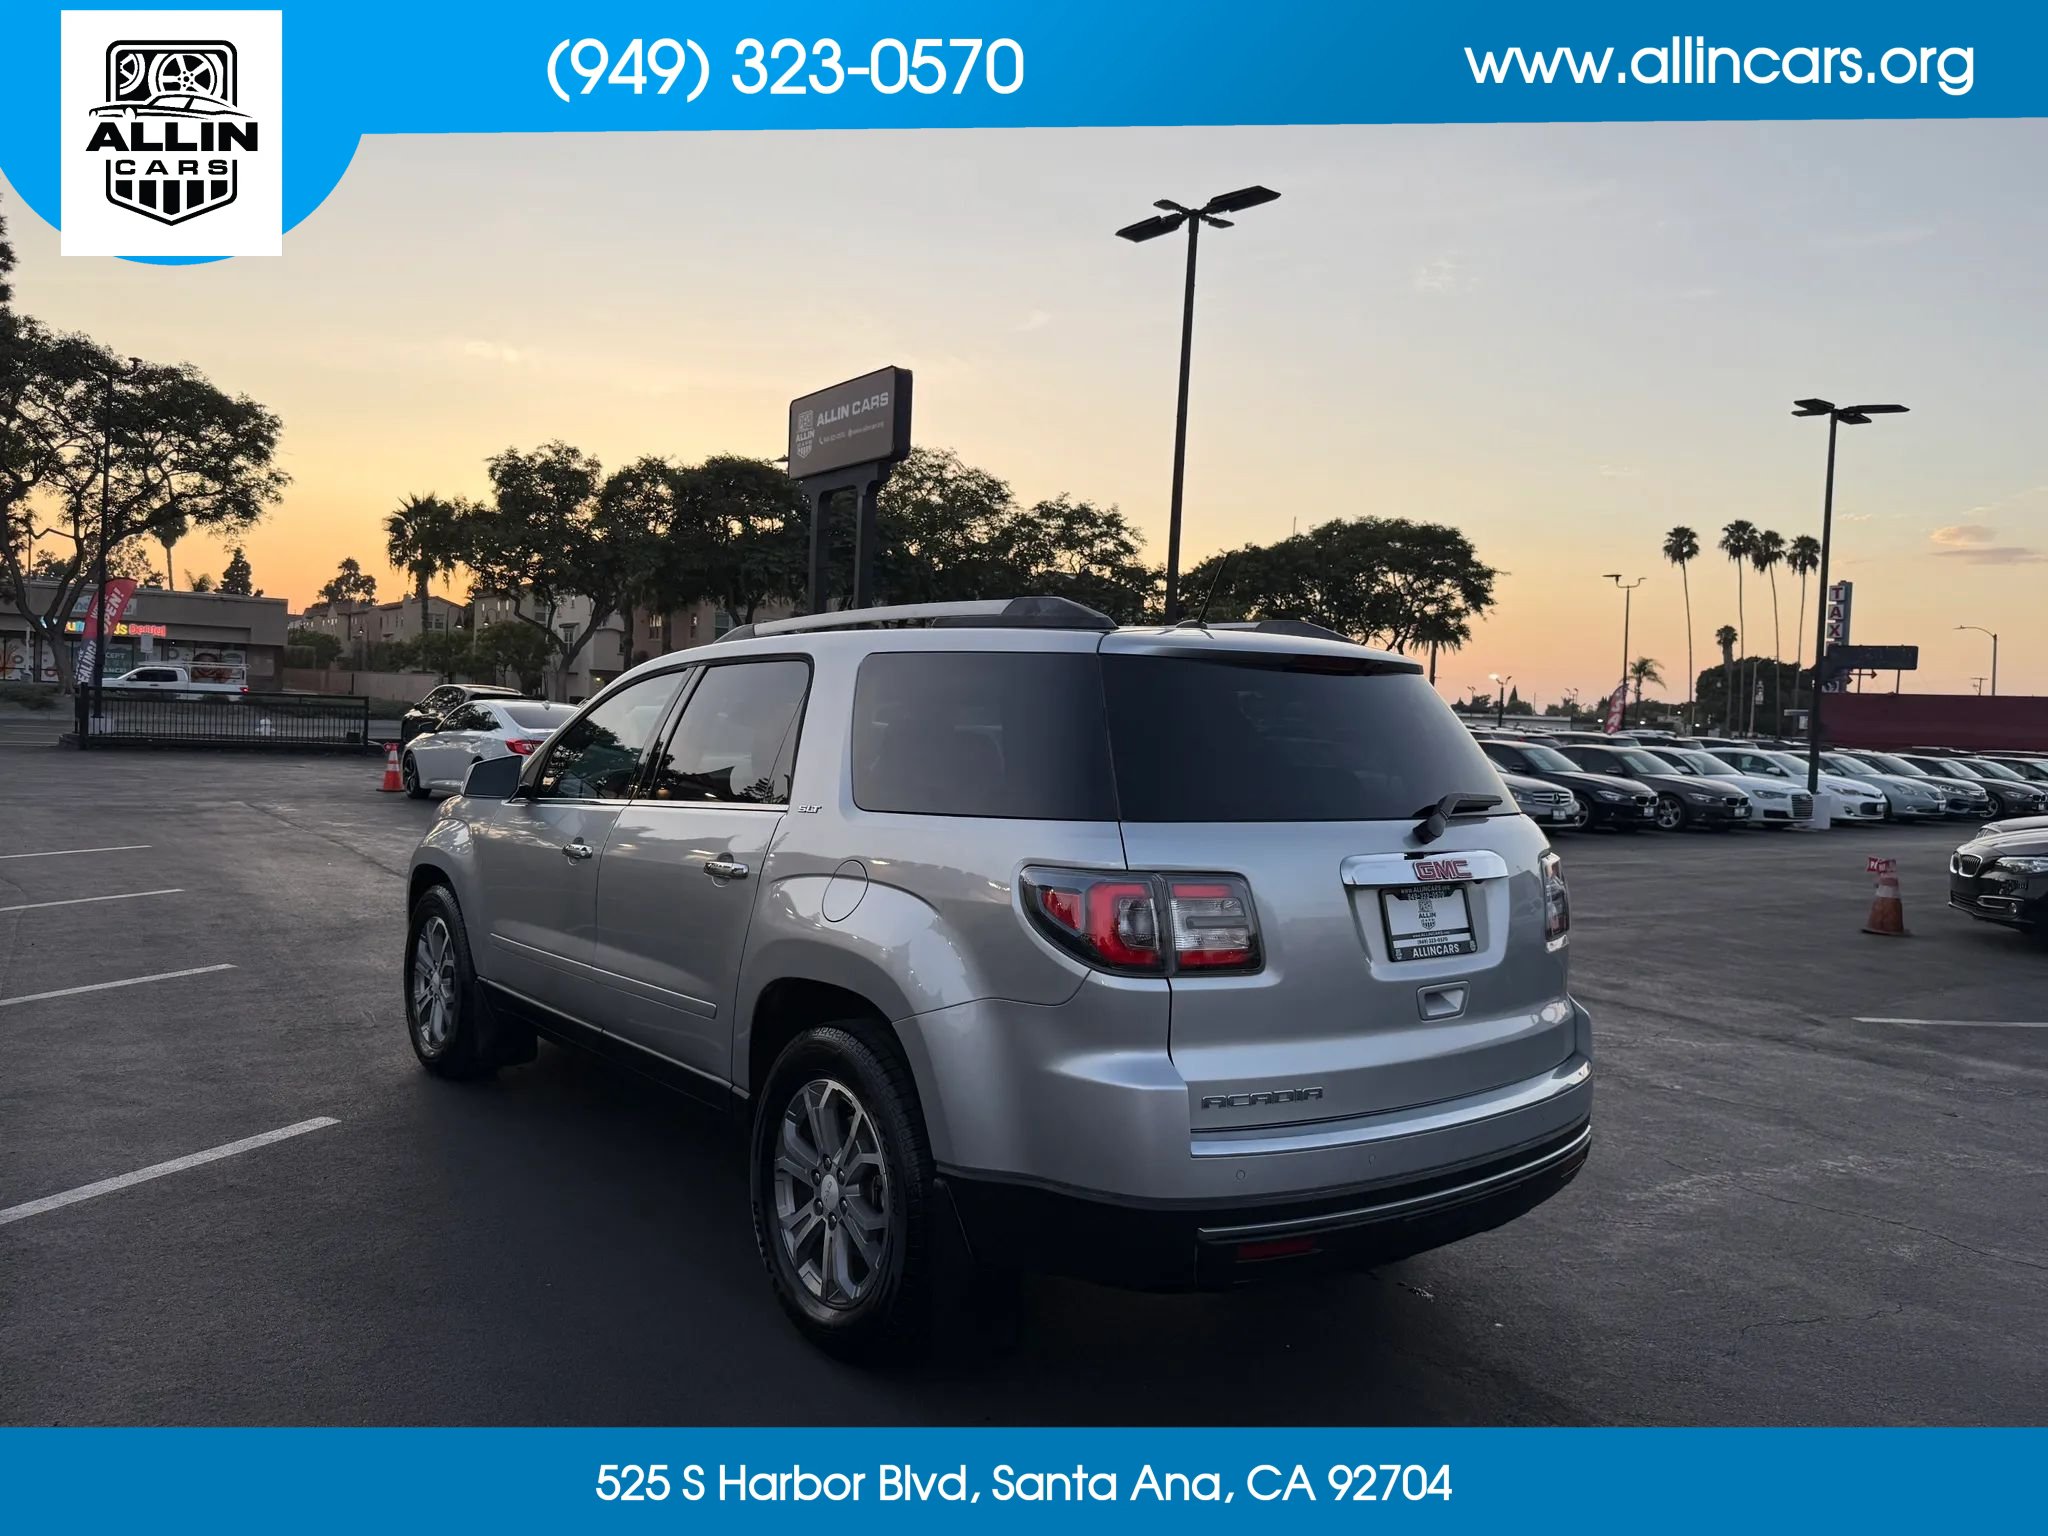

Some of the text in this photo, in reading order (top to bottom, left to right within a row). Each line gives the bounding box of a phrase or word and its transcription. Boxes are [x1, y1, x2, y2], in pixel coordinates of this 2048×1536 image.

[817, 391, 888, 426] ALLIN CARS
[128, 623, 167, 637] Dental
[798, 805, 822, 814] SLT
[1415, 859, 1473, 880] GMC
[1413, 943, 1460, 959] ALLINCARS
[1201, 1086, 1324, 1110] ACADIA
